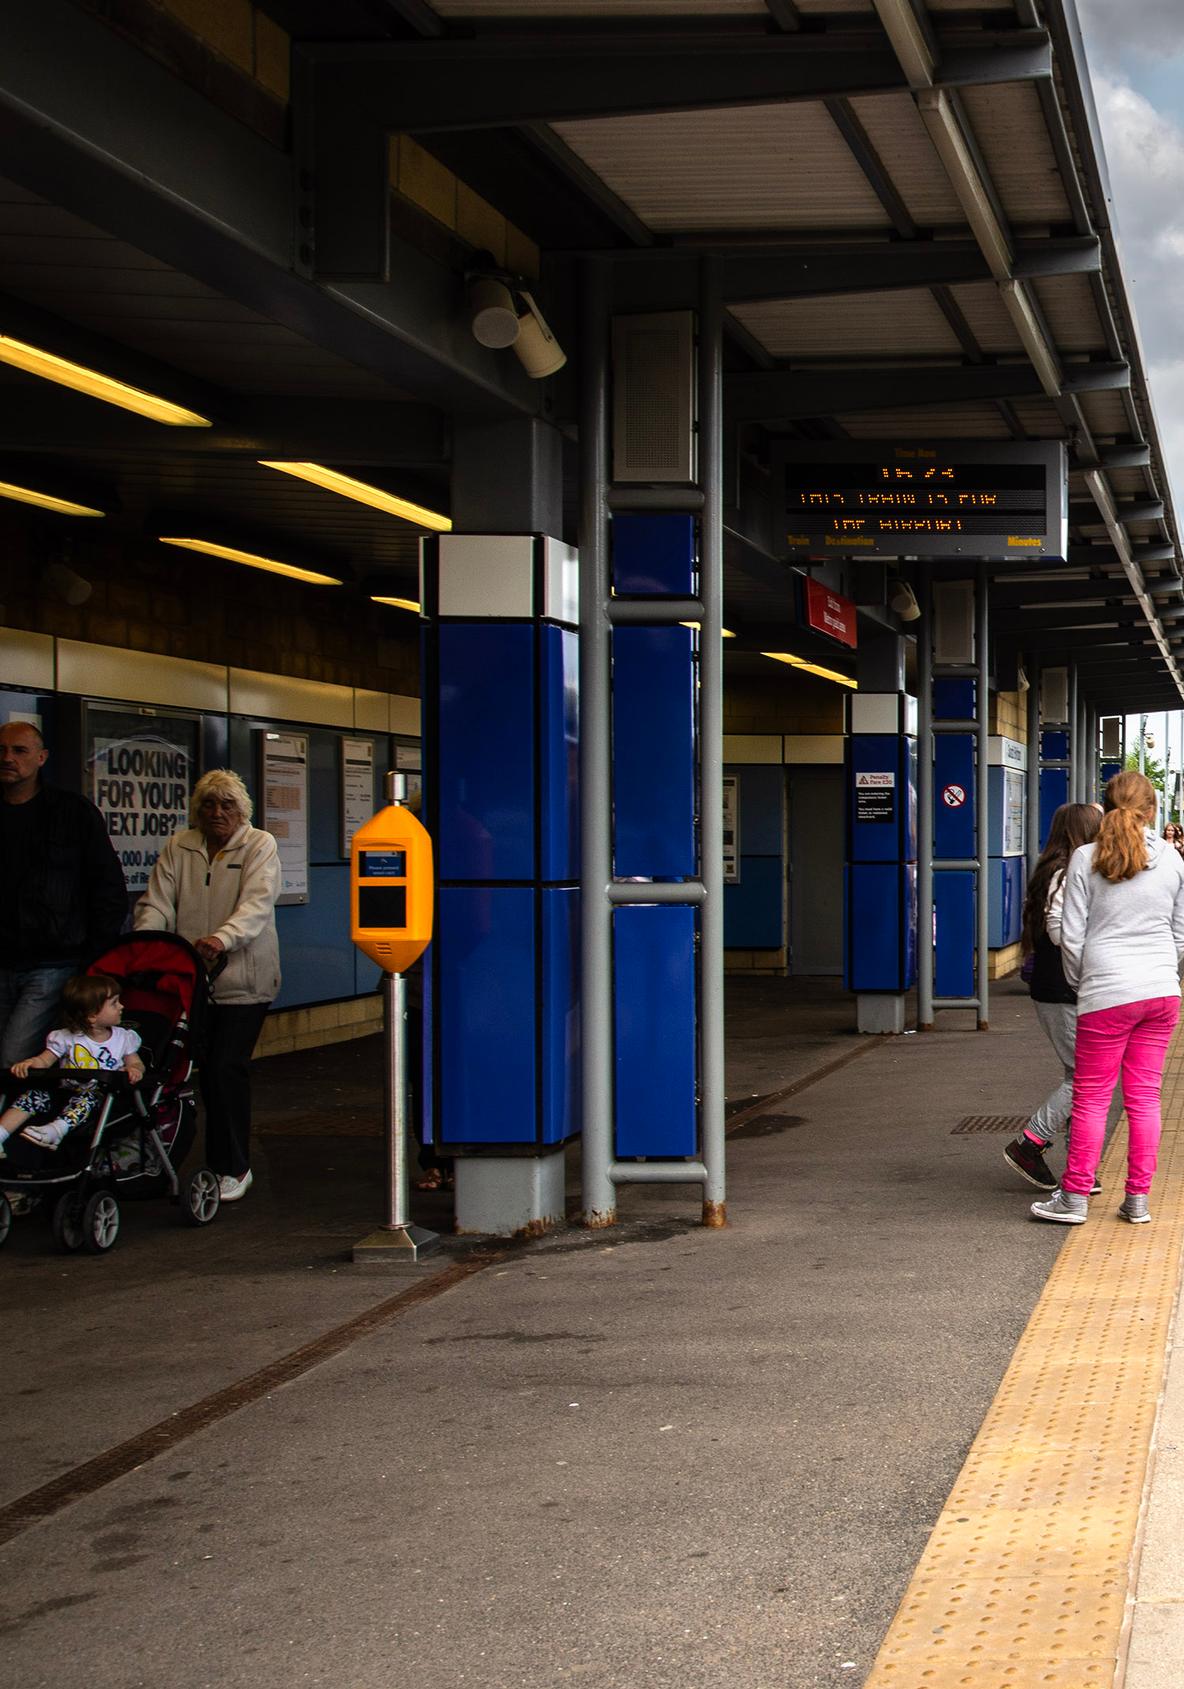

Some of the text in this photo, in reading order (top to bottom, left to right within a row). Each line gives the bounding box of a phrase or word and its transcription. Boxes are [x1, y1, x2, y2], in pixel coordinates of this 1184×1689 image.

[787, 534, 1042, 547] Train Destination Minutes
[96, 778, 186, 811] FOR YOUR
